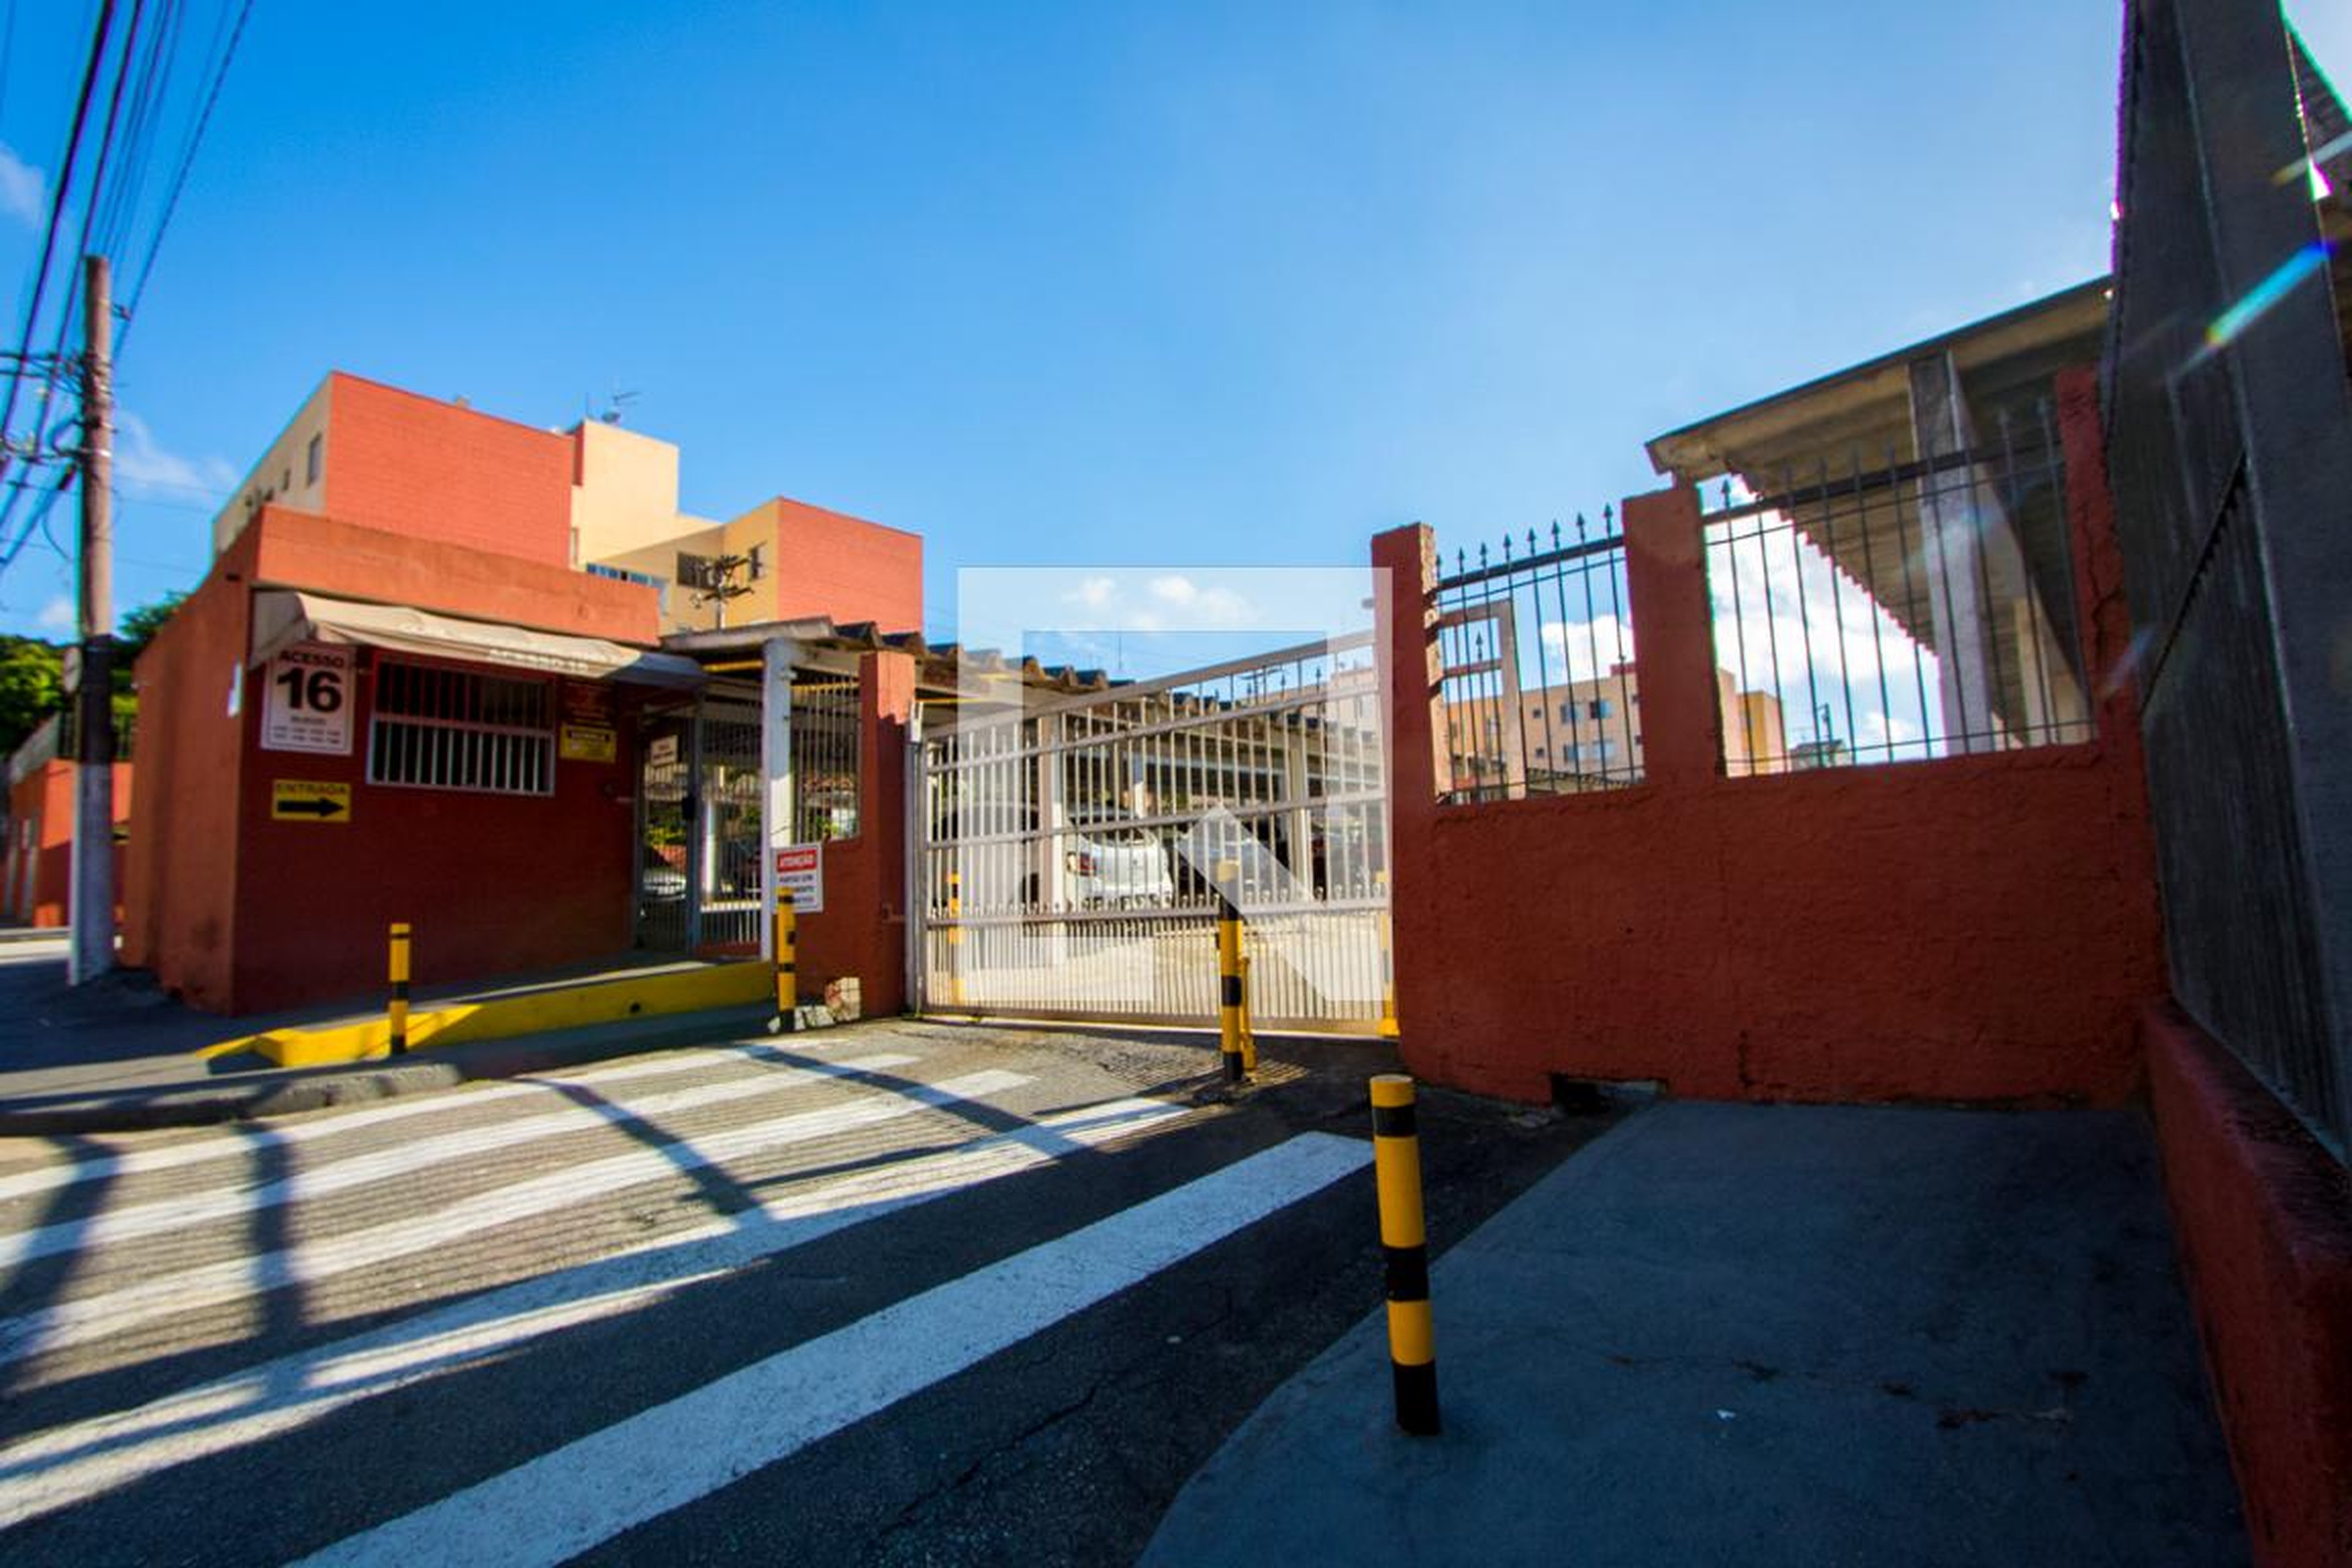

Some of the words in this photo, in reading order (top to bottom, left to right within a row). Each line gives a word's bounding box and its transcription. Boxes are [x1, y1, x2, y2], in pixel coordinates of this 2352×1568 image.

[279, 649, 344, 666] ACESSO
[277, 667, 342, 712] 16
[276, 783, 346, 795] ENTRADA
